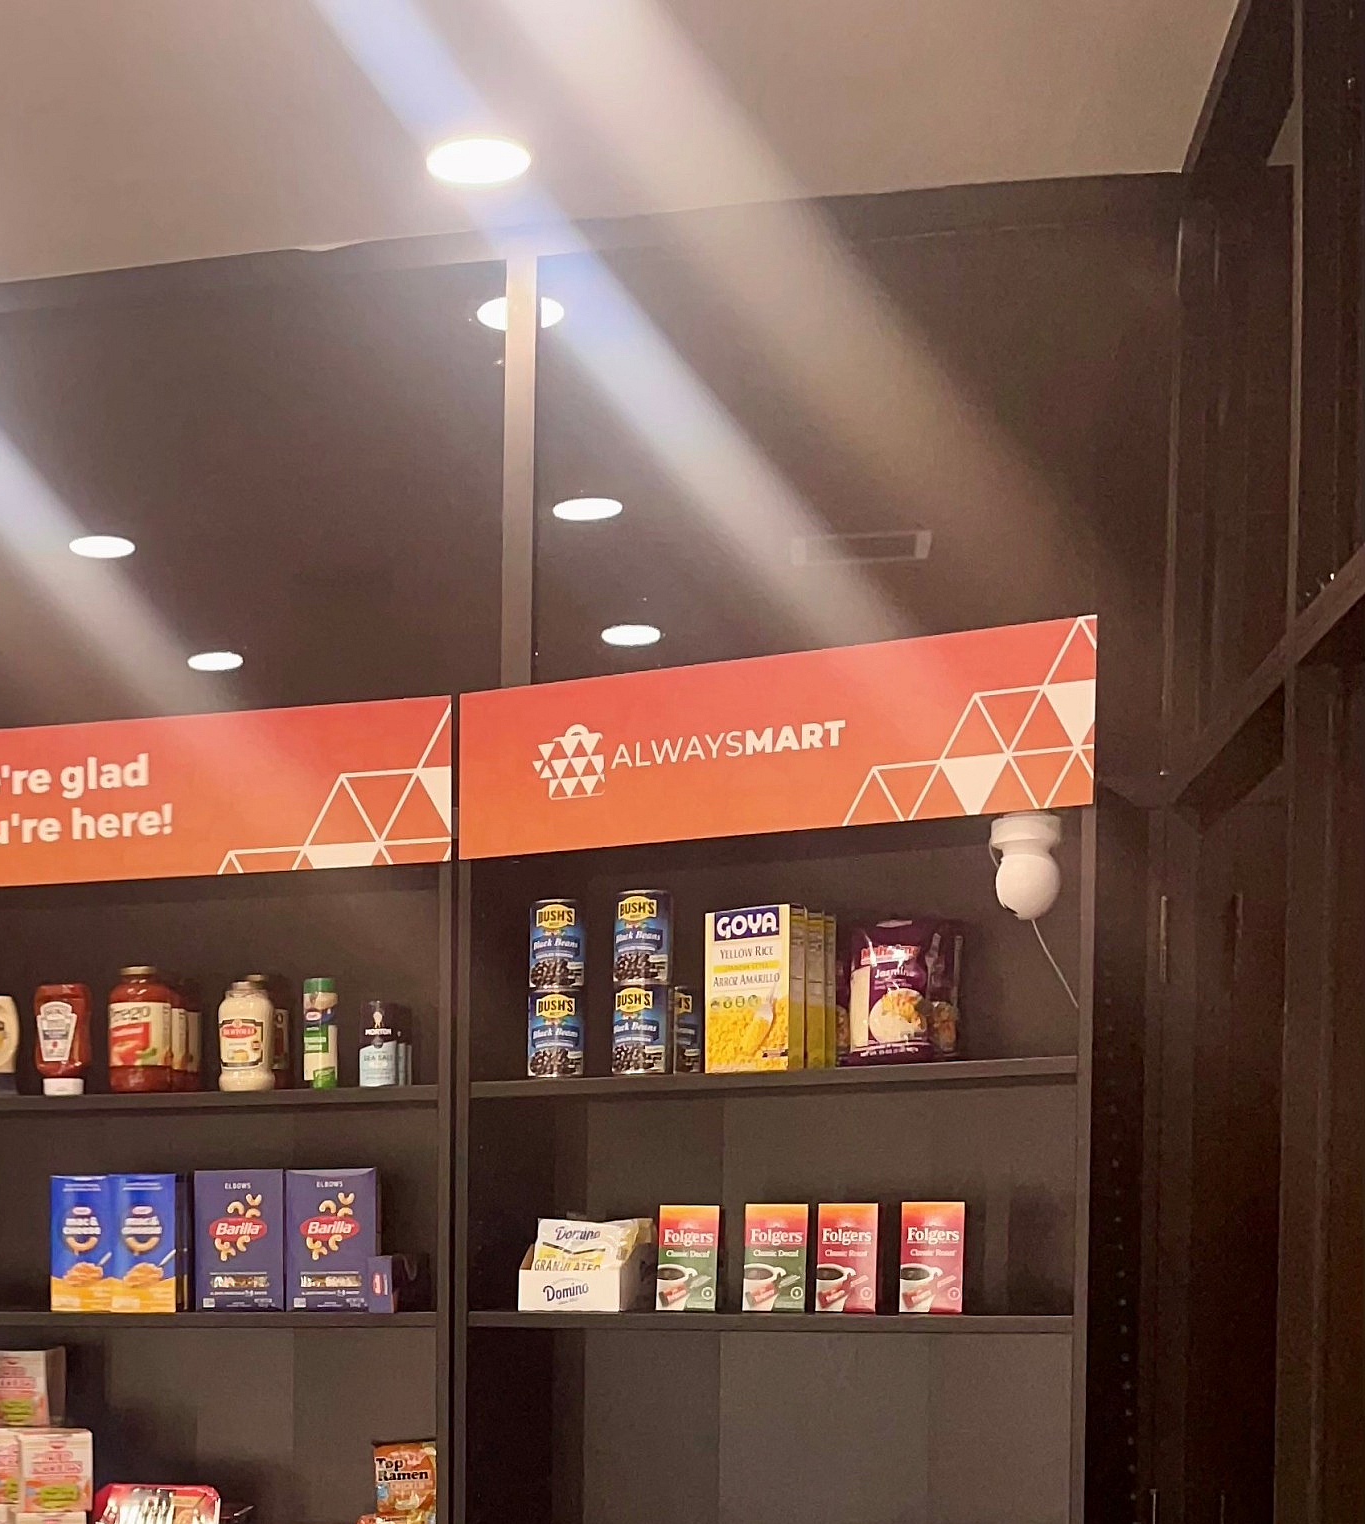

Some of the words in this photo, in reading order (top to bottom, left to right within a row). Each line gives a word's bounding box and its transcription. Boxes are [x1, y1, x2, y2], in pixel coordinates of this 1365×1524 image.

[610, 719, 846, 771] ALWAYSMART
[60, 752, 149, 799] glad
[71, 803, 174, 841] here!
[538, 909, 573, 922] BUSH'S
[620, 901, 654, 916] BUSH'S
[716, 911, 778, 940] GOYA
[719, 947, 753, 960] YELLOW
[755, 944, 774, 957] RICE
[713, 974, 738, 988] ARROZ
[740, 971, 781, 986] AMARILLO
[538, 999, 573, 1013] BUSH'S
[617, 993, 651, 1008] BUSH'S
[215, 1221, 261, 1236] Barilla
[306, 1220, 353, 1235] Barilla
[906, 1226, 960, 1245] Folgers
[663, 1228, 714, 1247] Folgers
[750, 1228, 803, 1246] Folgers
[821, 1227, 872, 1246] Folgers
[543, 1283, 590, 1302] Domino
[376, 1457, 404, 1473] Top
[378, 1470, 429, 1482] Ramen
